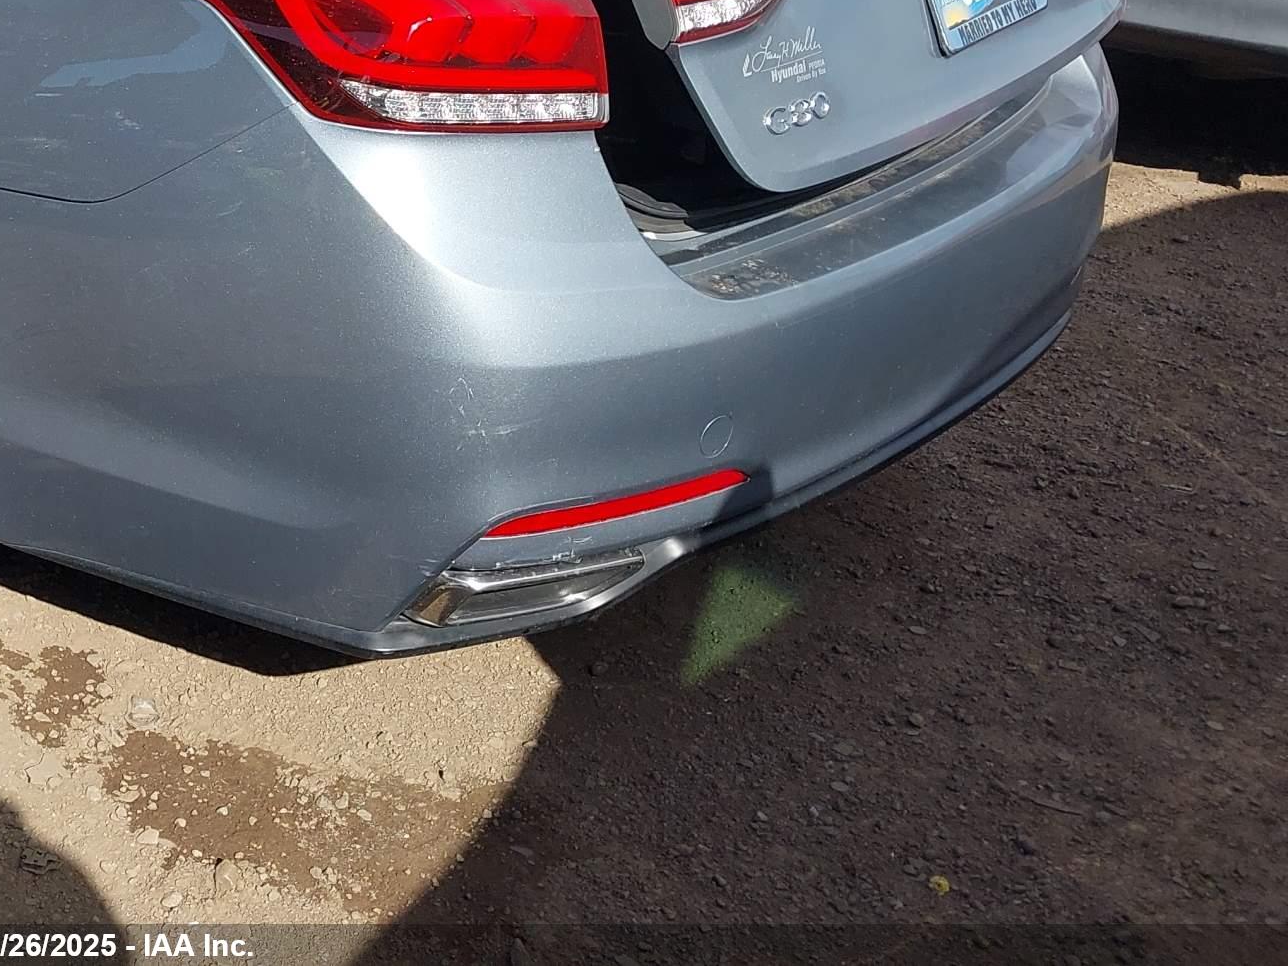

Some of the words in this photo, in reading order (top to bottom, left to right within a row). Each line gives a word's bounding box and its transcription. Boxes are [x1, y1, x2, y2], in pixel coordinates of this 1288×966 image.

[958, 14, 994, 46] MARRIED
[991, 9, 1004, 29] TO
[1001, 1, 1017, 25] MY
[771, 59, 806, 83] Hyundai
